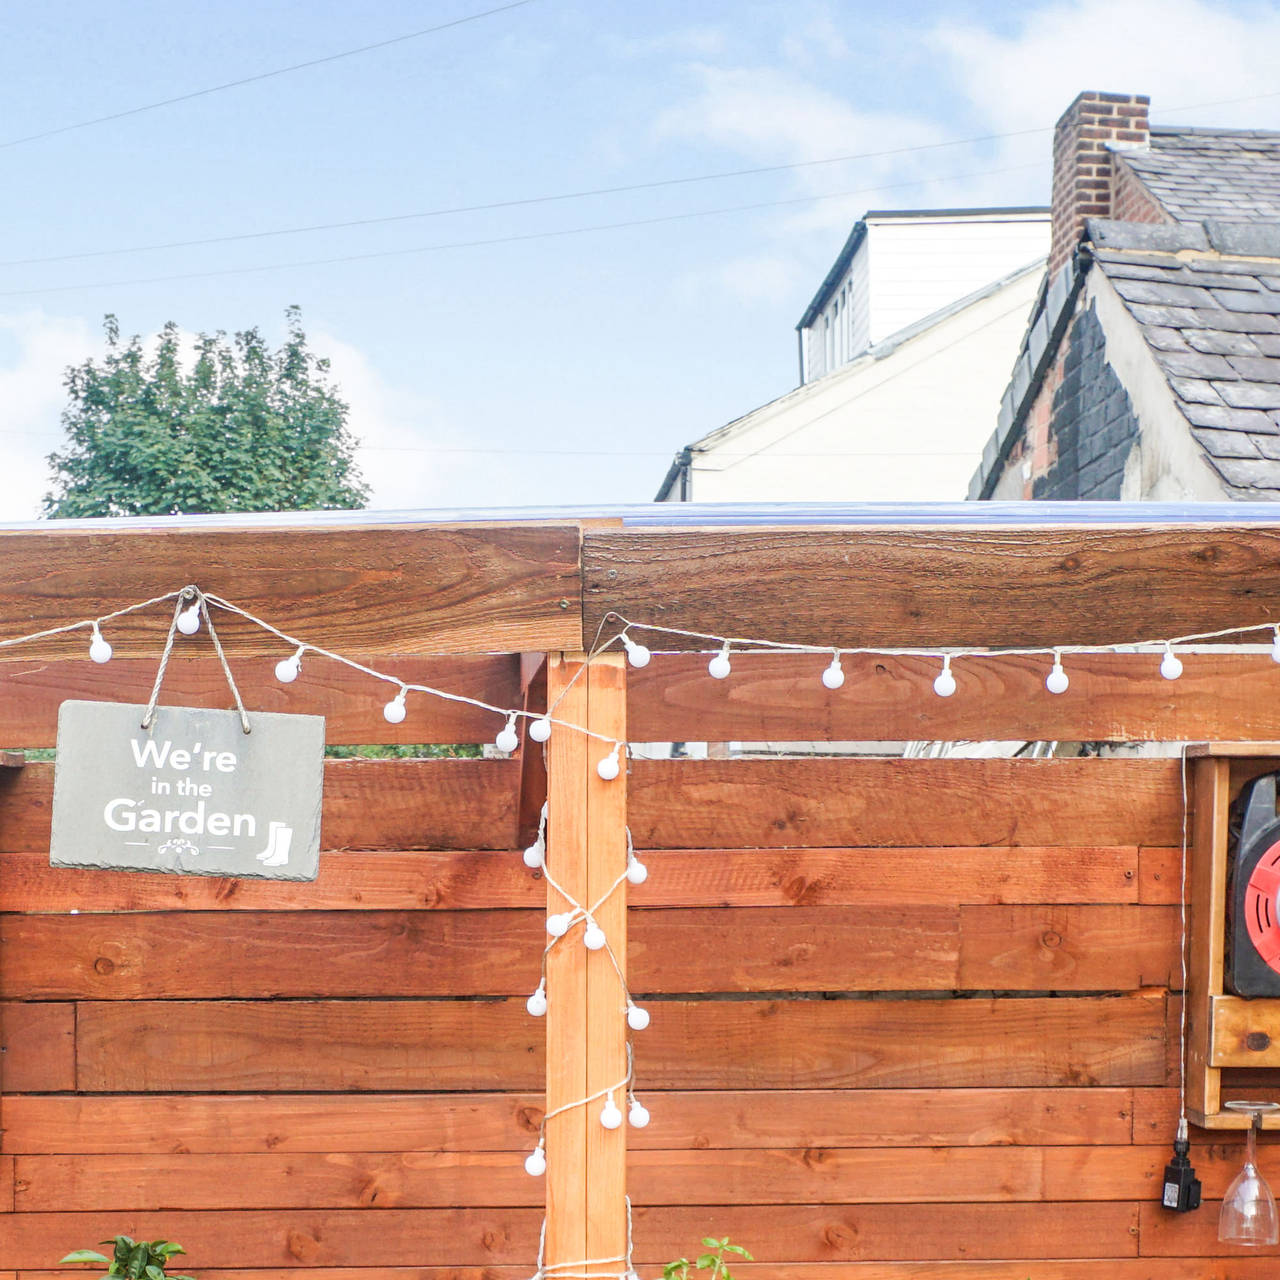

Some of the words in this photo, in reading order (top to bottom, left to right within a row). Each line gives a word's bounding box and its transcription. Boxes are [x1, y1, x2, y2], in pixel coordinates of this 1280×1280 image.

[130, 739, 238, 773] We're
[151, 777, 170, 796] in
[176, 777, 213, 798] the
[103, 798, 257, 838] Garden
